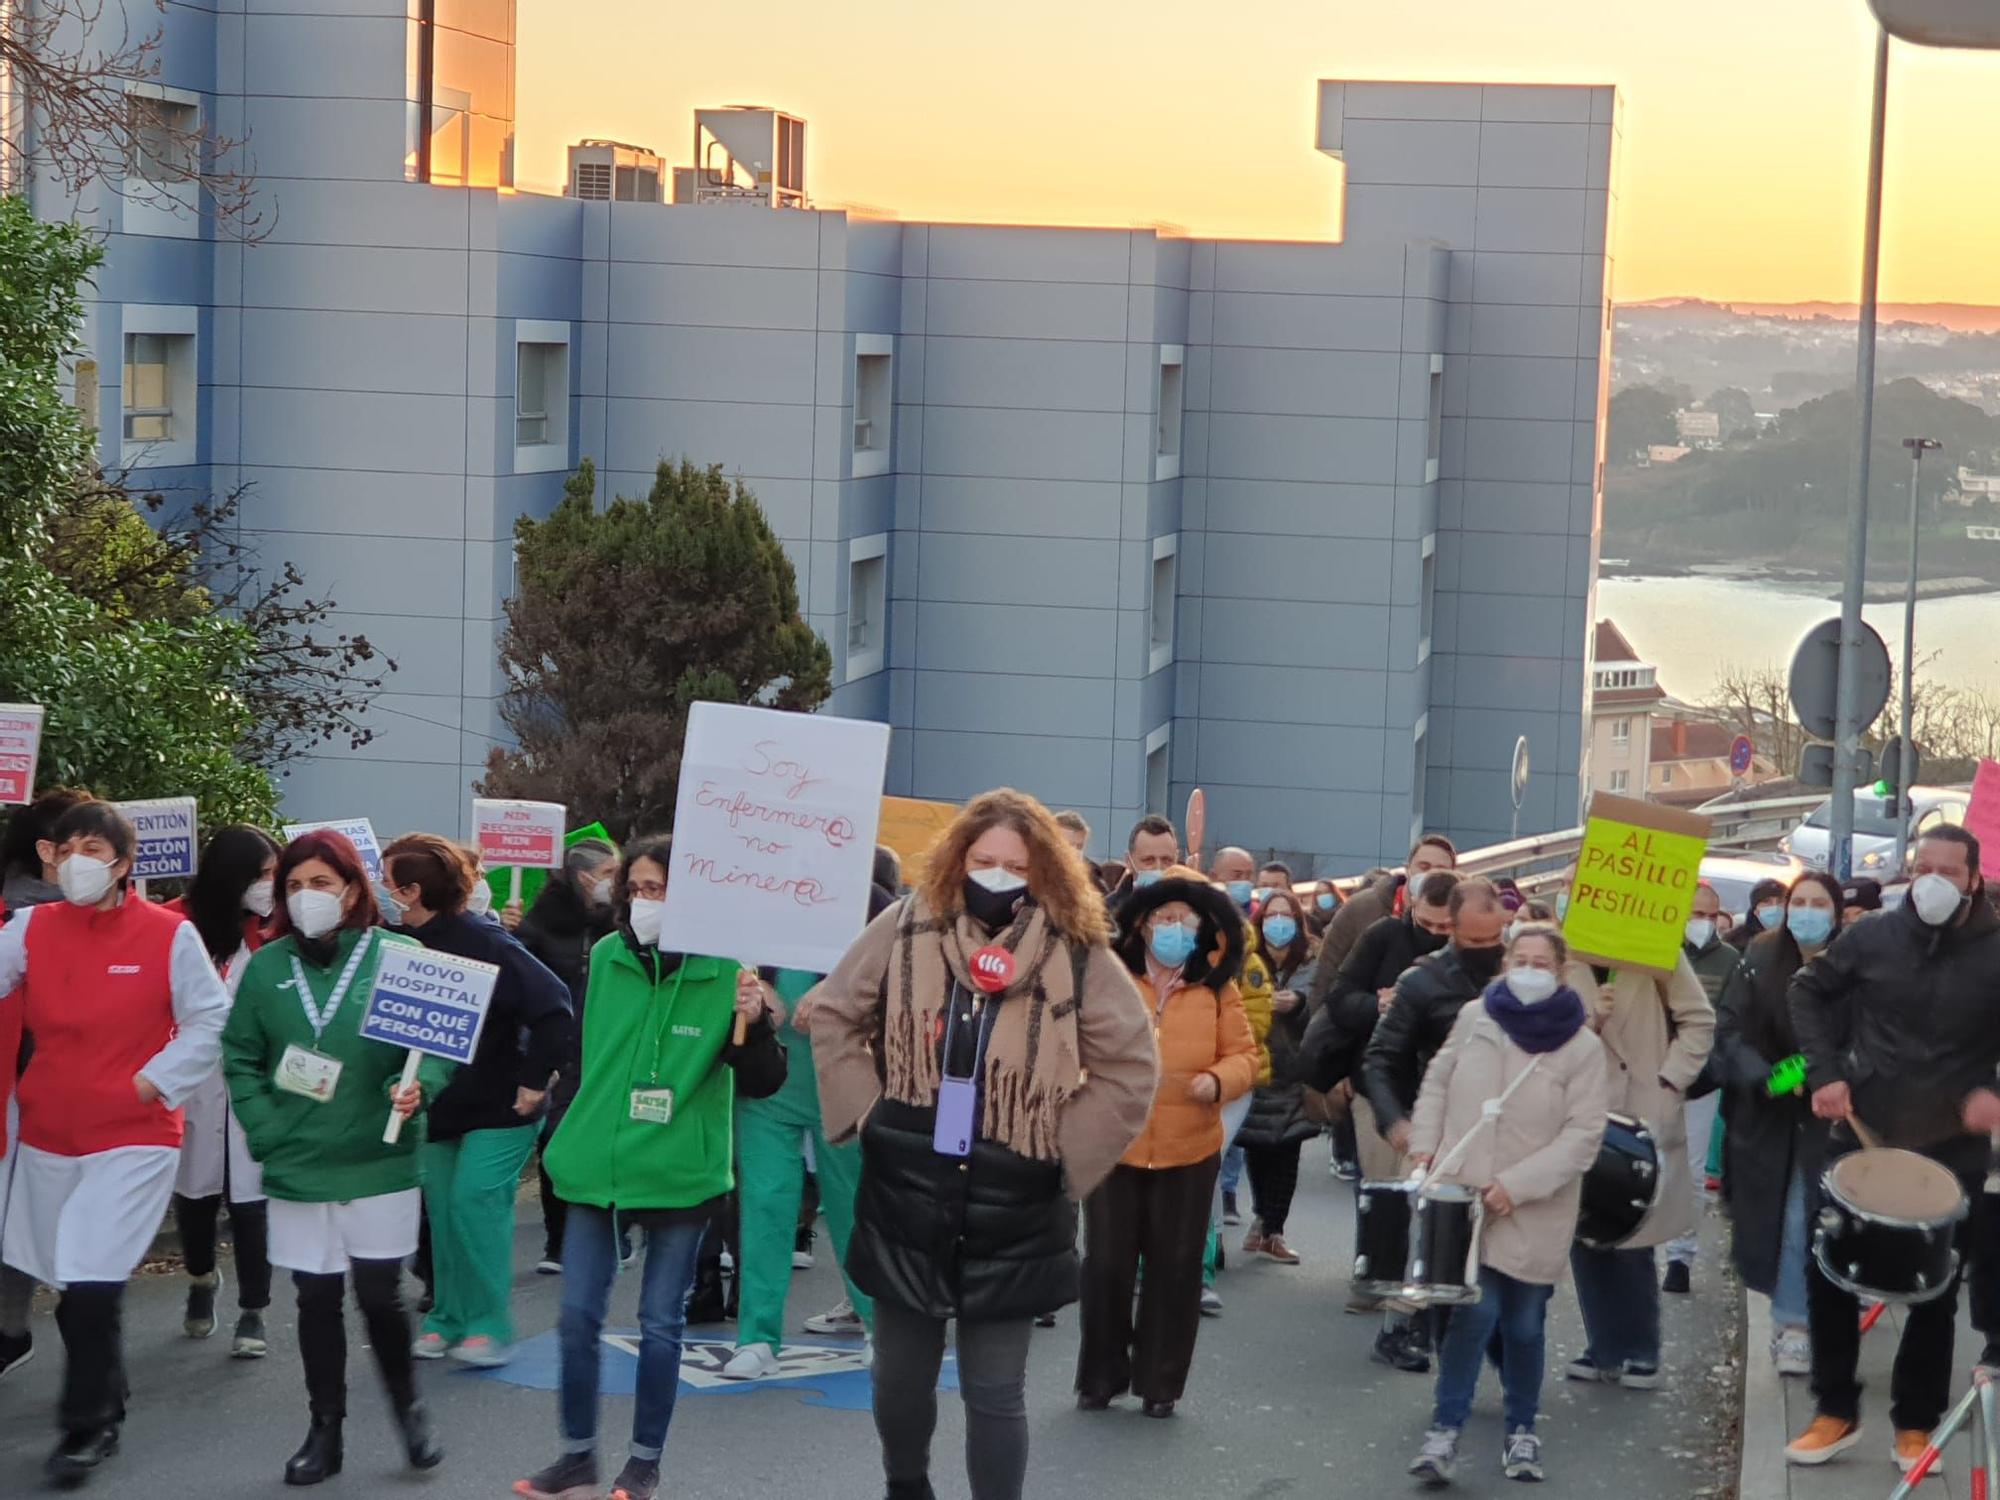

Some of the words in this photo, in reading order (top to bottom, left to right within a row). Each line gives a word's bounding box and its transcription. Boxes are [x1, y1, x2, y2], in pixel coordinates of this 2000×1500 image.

[744, 740, 831, 799] Soy
[696, 780, 856, 847] Enfermer@
[737, 835, 793, 854] no
[1622, 831, 1656, 858] AL
[684, 852, 839, 906] Miner@
[1584, 846, 1688, 890] PASILLO
[1575, 883, 1679, 924] PESTILLO
[380, 971, 480, 1007] HOSPITAL
[406, 959, 465, 983] NOVO
[367, 1014, 470, 1049] PERSOAL?
[377, 999, 423, 1020] CON
[426, 1012, 470, 1031] QUÉ
